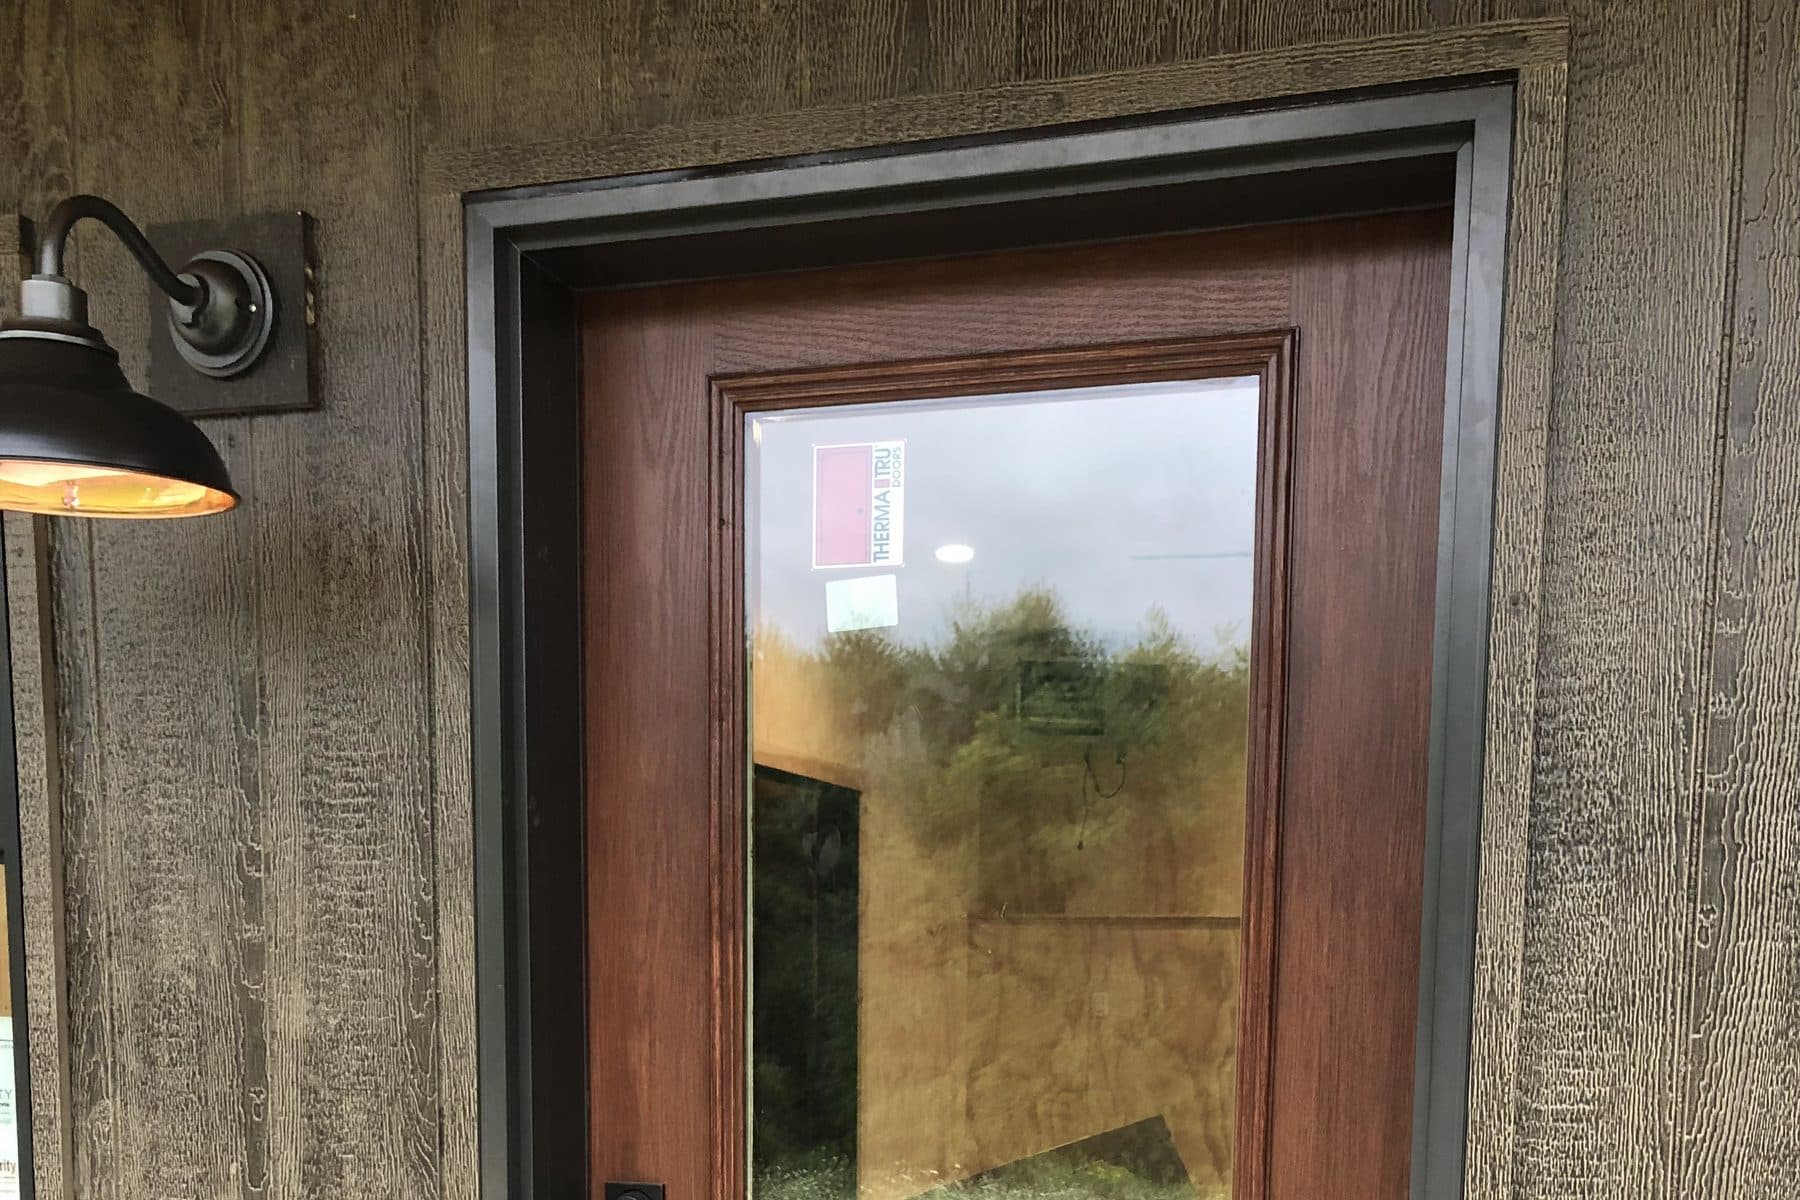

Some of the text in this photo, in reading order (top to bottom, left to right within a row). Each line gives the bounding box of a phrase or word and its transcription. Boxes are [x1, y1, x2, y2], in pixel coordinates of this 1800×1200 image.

[873, 448, 891, 563] THERMA TRU
[892, 447, 901, 488] DOORS
